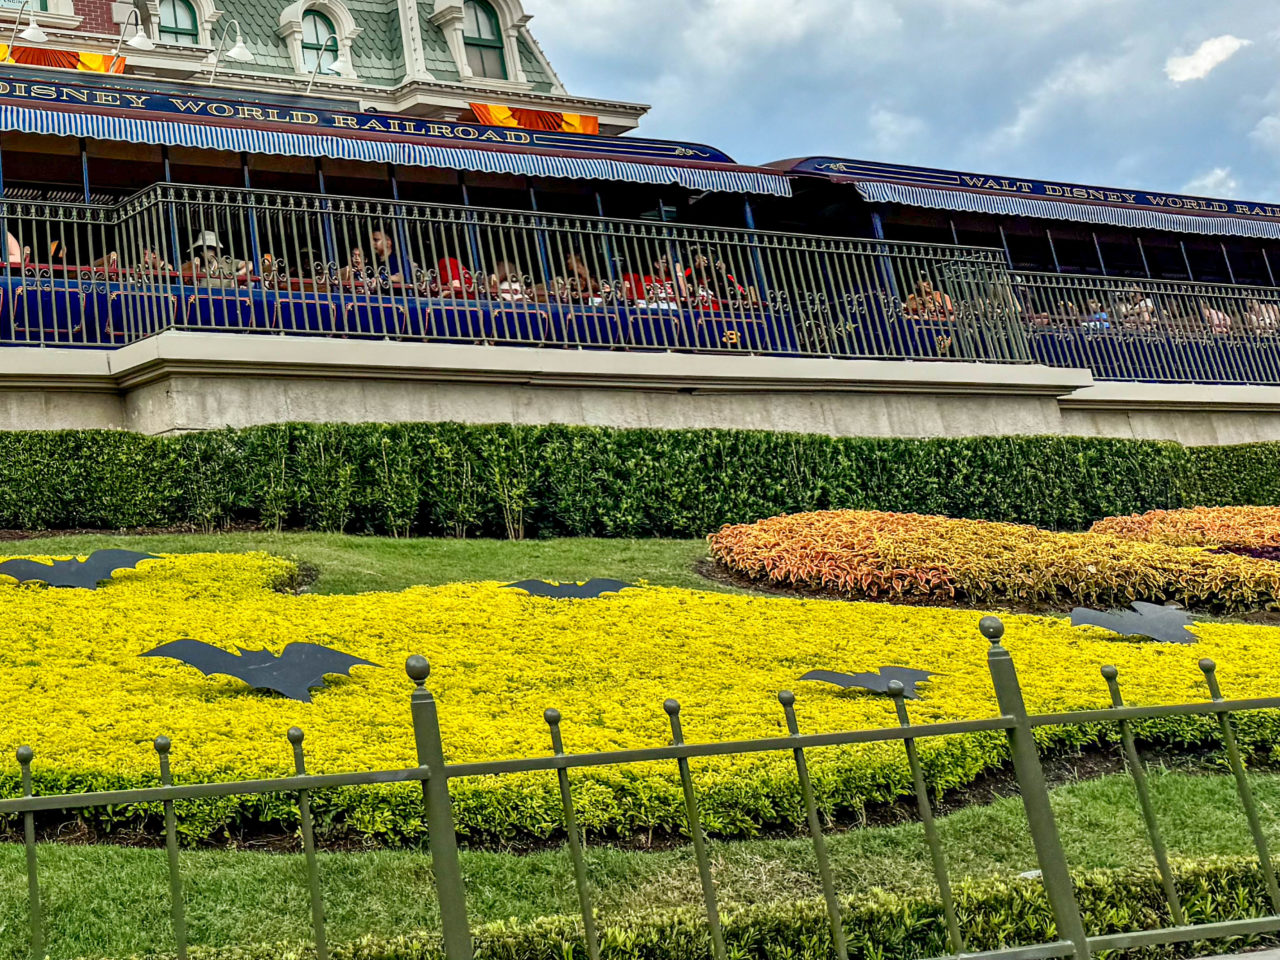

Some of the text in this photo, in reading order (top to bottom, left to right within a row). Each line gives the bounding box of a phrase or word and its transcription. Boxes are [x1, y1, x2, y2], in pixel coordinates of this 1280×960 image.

[169, 98, 318, 124] WORLD
[331, 115, 530, 144] RAILROAD
[961, 175, 1033, 192] WALT
[1044, 184, 1136, 203] DISNEY
[1146, 195, 1228, 212] WORLD
